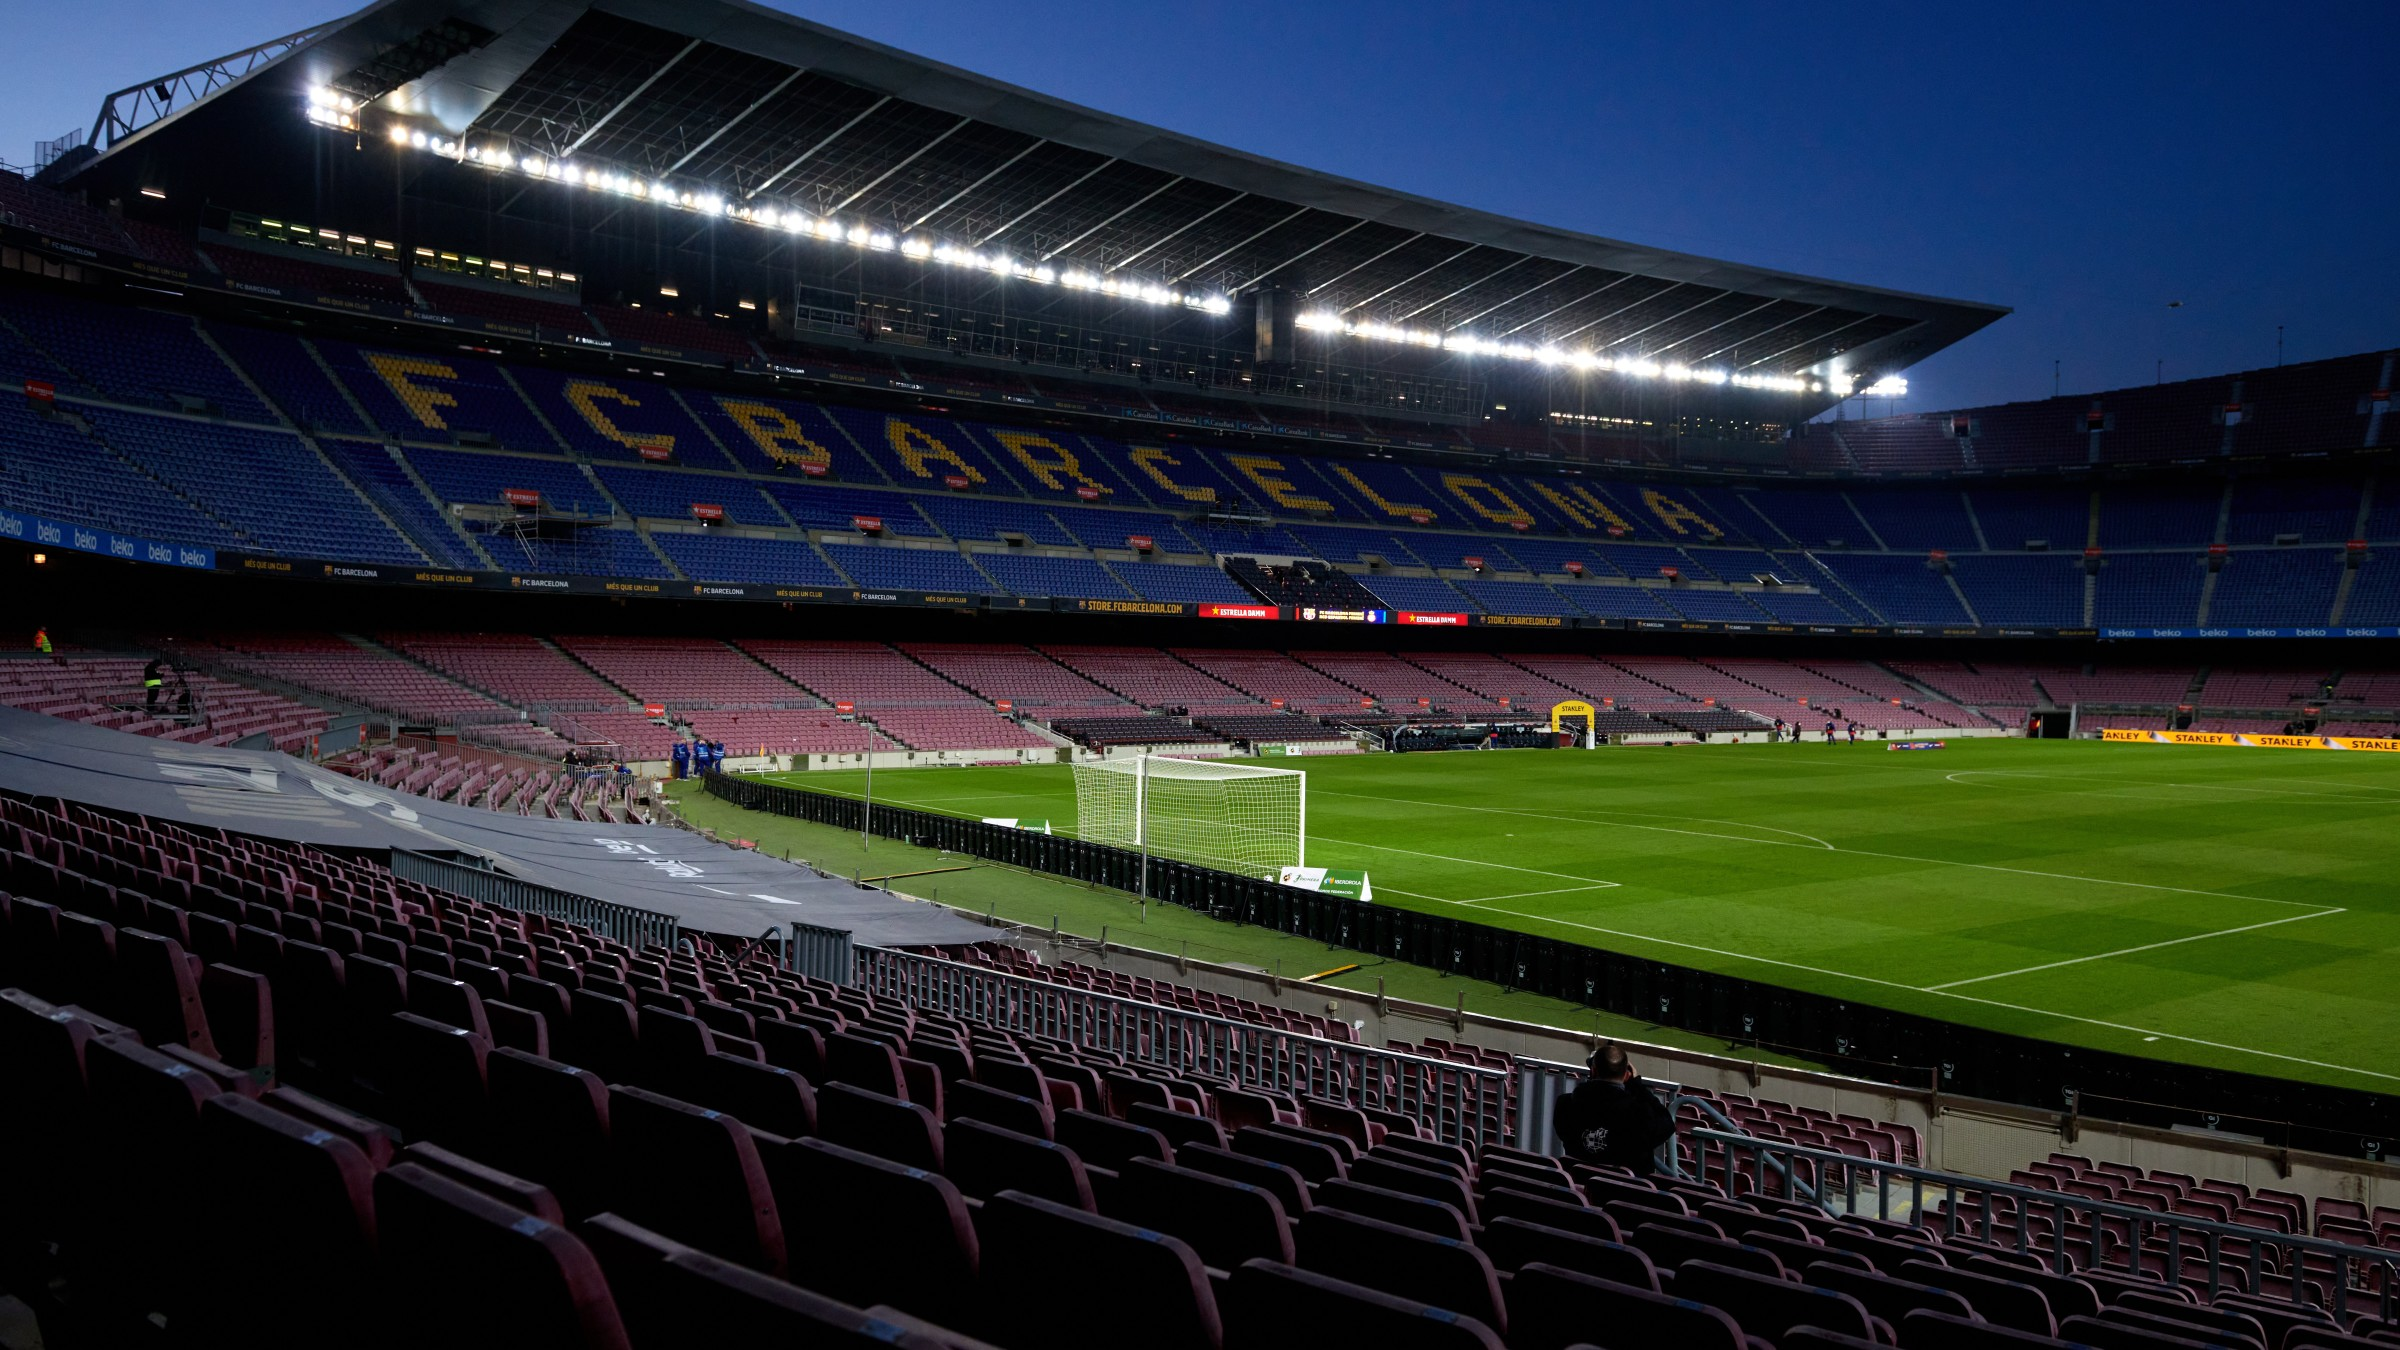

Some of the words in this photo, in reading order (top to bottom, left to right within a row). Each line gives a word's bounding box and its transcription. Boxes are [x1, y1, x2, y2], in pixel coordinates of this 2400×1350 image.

[37, 520, 61, 543] beko
[75, 528, 97, 550] beko
[111, 536, 134, 557] beko
[149, 543, 172, 562] beko
[181, 548, 206, 567] beko
[257, 560, 267, 569] QUE
[268, 561, 276, 569] UN
[277, 562, 292, 571] CLUB
[342, 569, 378, 578] BARCELONA
[431, 574, 444, 582] QUE
[456, 575, 473, 583] CLUB
[531, 580, 569, 588] BARCELONA
[621, 583, 633, 591] QUE
[1088, 601, 1183, 614] STORE.FCBARCELONA.COM
[1220, 608, 1247, 616] ESTRELLA
[1248, 609, 1265, 617] DAMM
[1487, 616, 1561, 626] STORE.FCBARCELONA.COM
[2108, 629, 2135, 637] beko
[2153, 629, 2181, 637] beko
[2200, 629, 2229, 637] beko
[2247, 628, 2276, 637] beko
[2296, 628, 2326, 637] beko
[2346, 628, 2377, 637] beko
[2176, 734, 2223, 743] STANLEY
[2260, 737, 2312, 747] STANLEY
